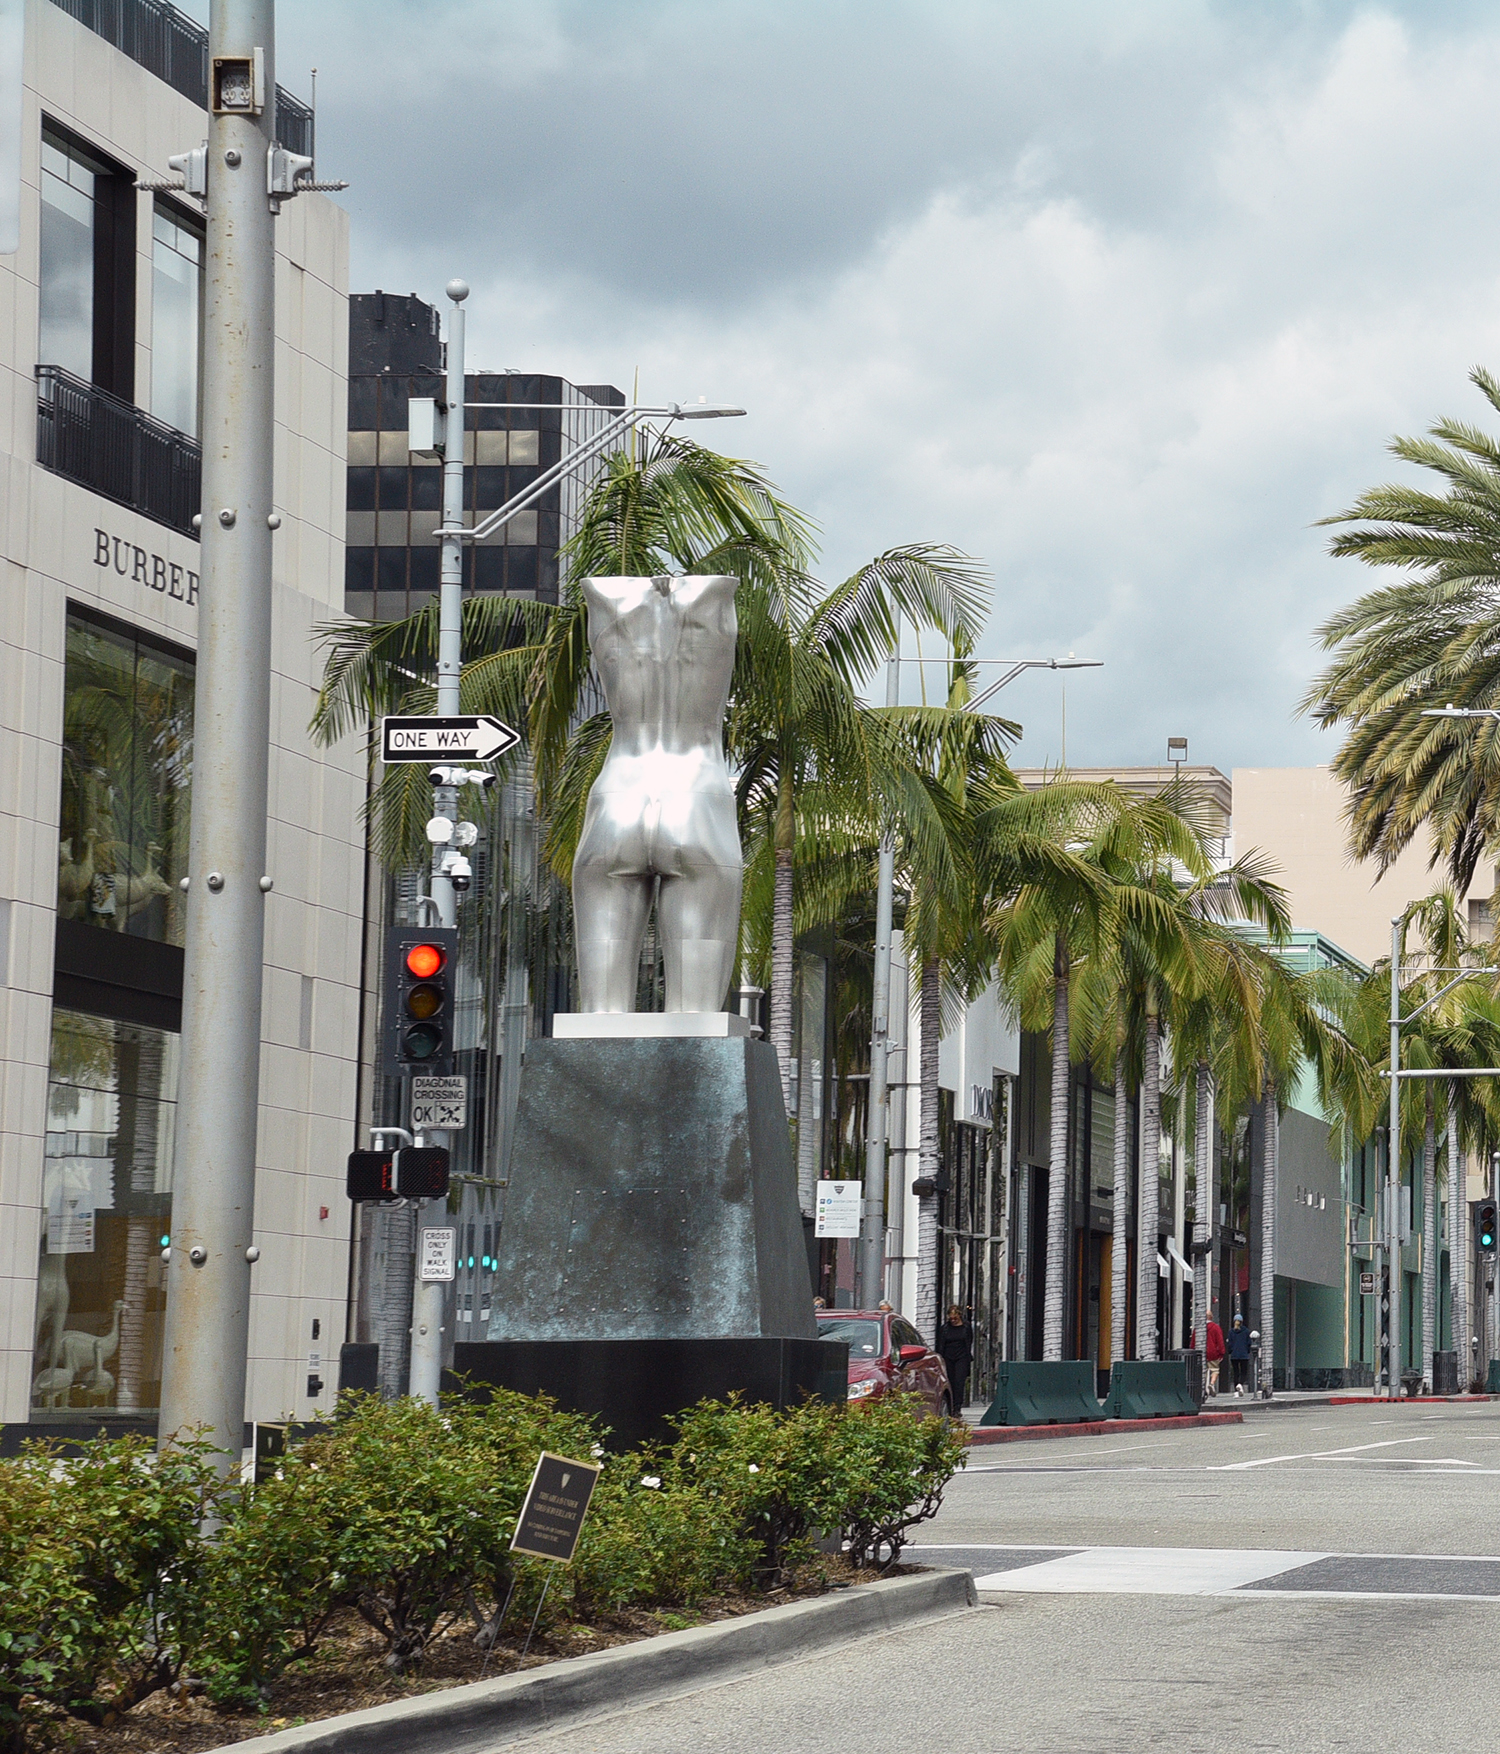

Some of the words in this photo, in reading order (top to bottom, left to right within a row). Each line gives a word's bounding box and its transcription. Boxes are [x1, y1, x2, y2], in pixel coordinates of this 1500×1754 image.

[394, 732, 428, 748] ONE
[436, 731, 471, 747] WAY
[415, 1078, 463, 1088] DIAGONAL
[413, 1090, 465, 1100] CROSSING
[413, 1106, 433, 1122] OK
[425, 1232, 451, 1240] CROSS
[428, 1241, 447, 1249] ONLY
[423, 1267, 450, 1275] SIGNAL
